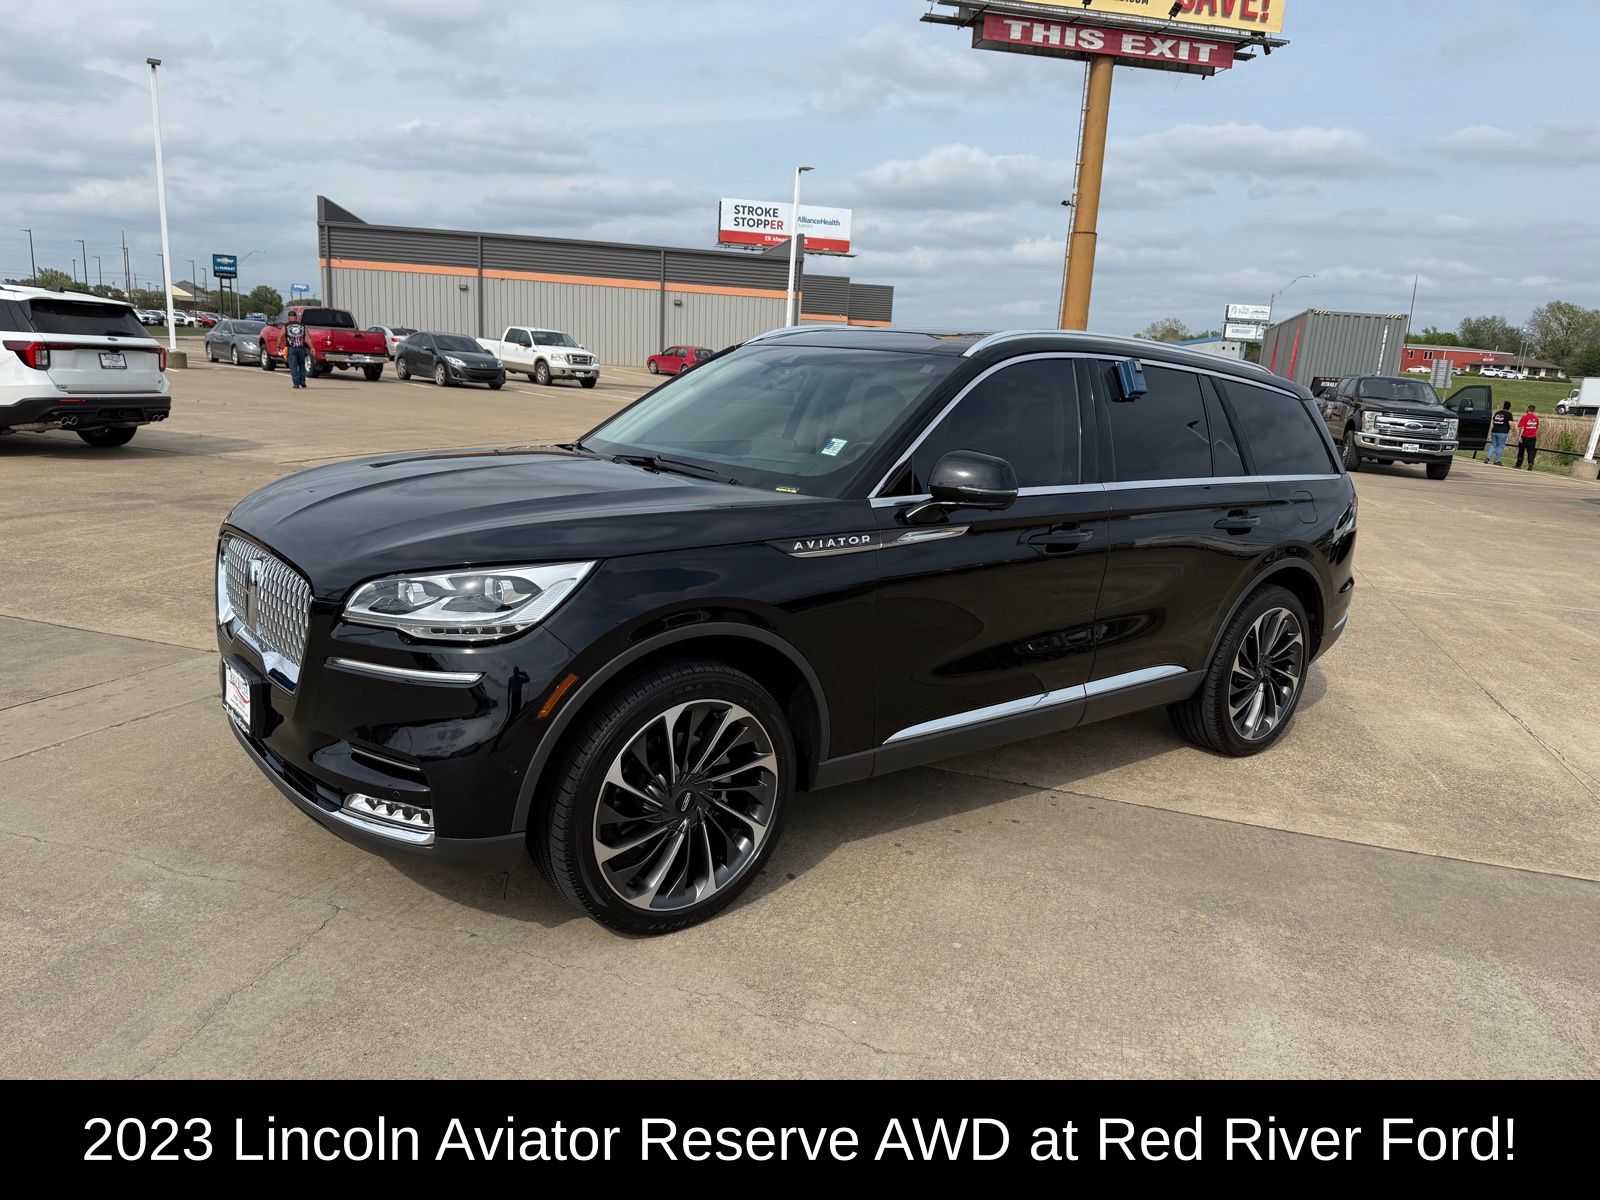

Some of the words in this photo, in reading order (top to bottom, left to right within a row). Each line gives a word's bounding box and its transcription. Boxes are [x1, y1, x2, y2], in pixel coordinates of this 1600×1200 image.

[1003, 19, 1105, 49] THIS
[1120, 33, 1218, 62] EXIT
[734, 204, 779, 218] STROKE
[733, 216, 784, 230] STOPPER
[797, 216, 841, 226] AllianceHealth
[793, 535, 871, 550] AVIATOR
